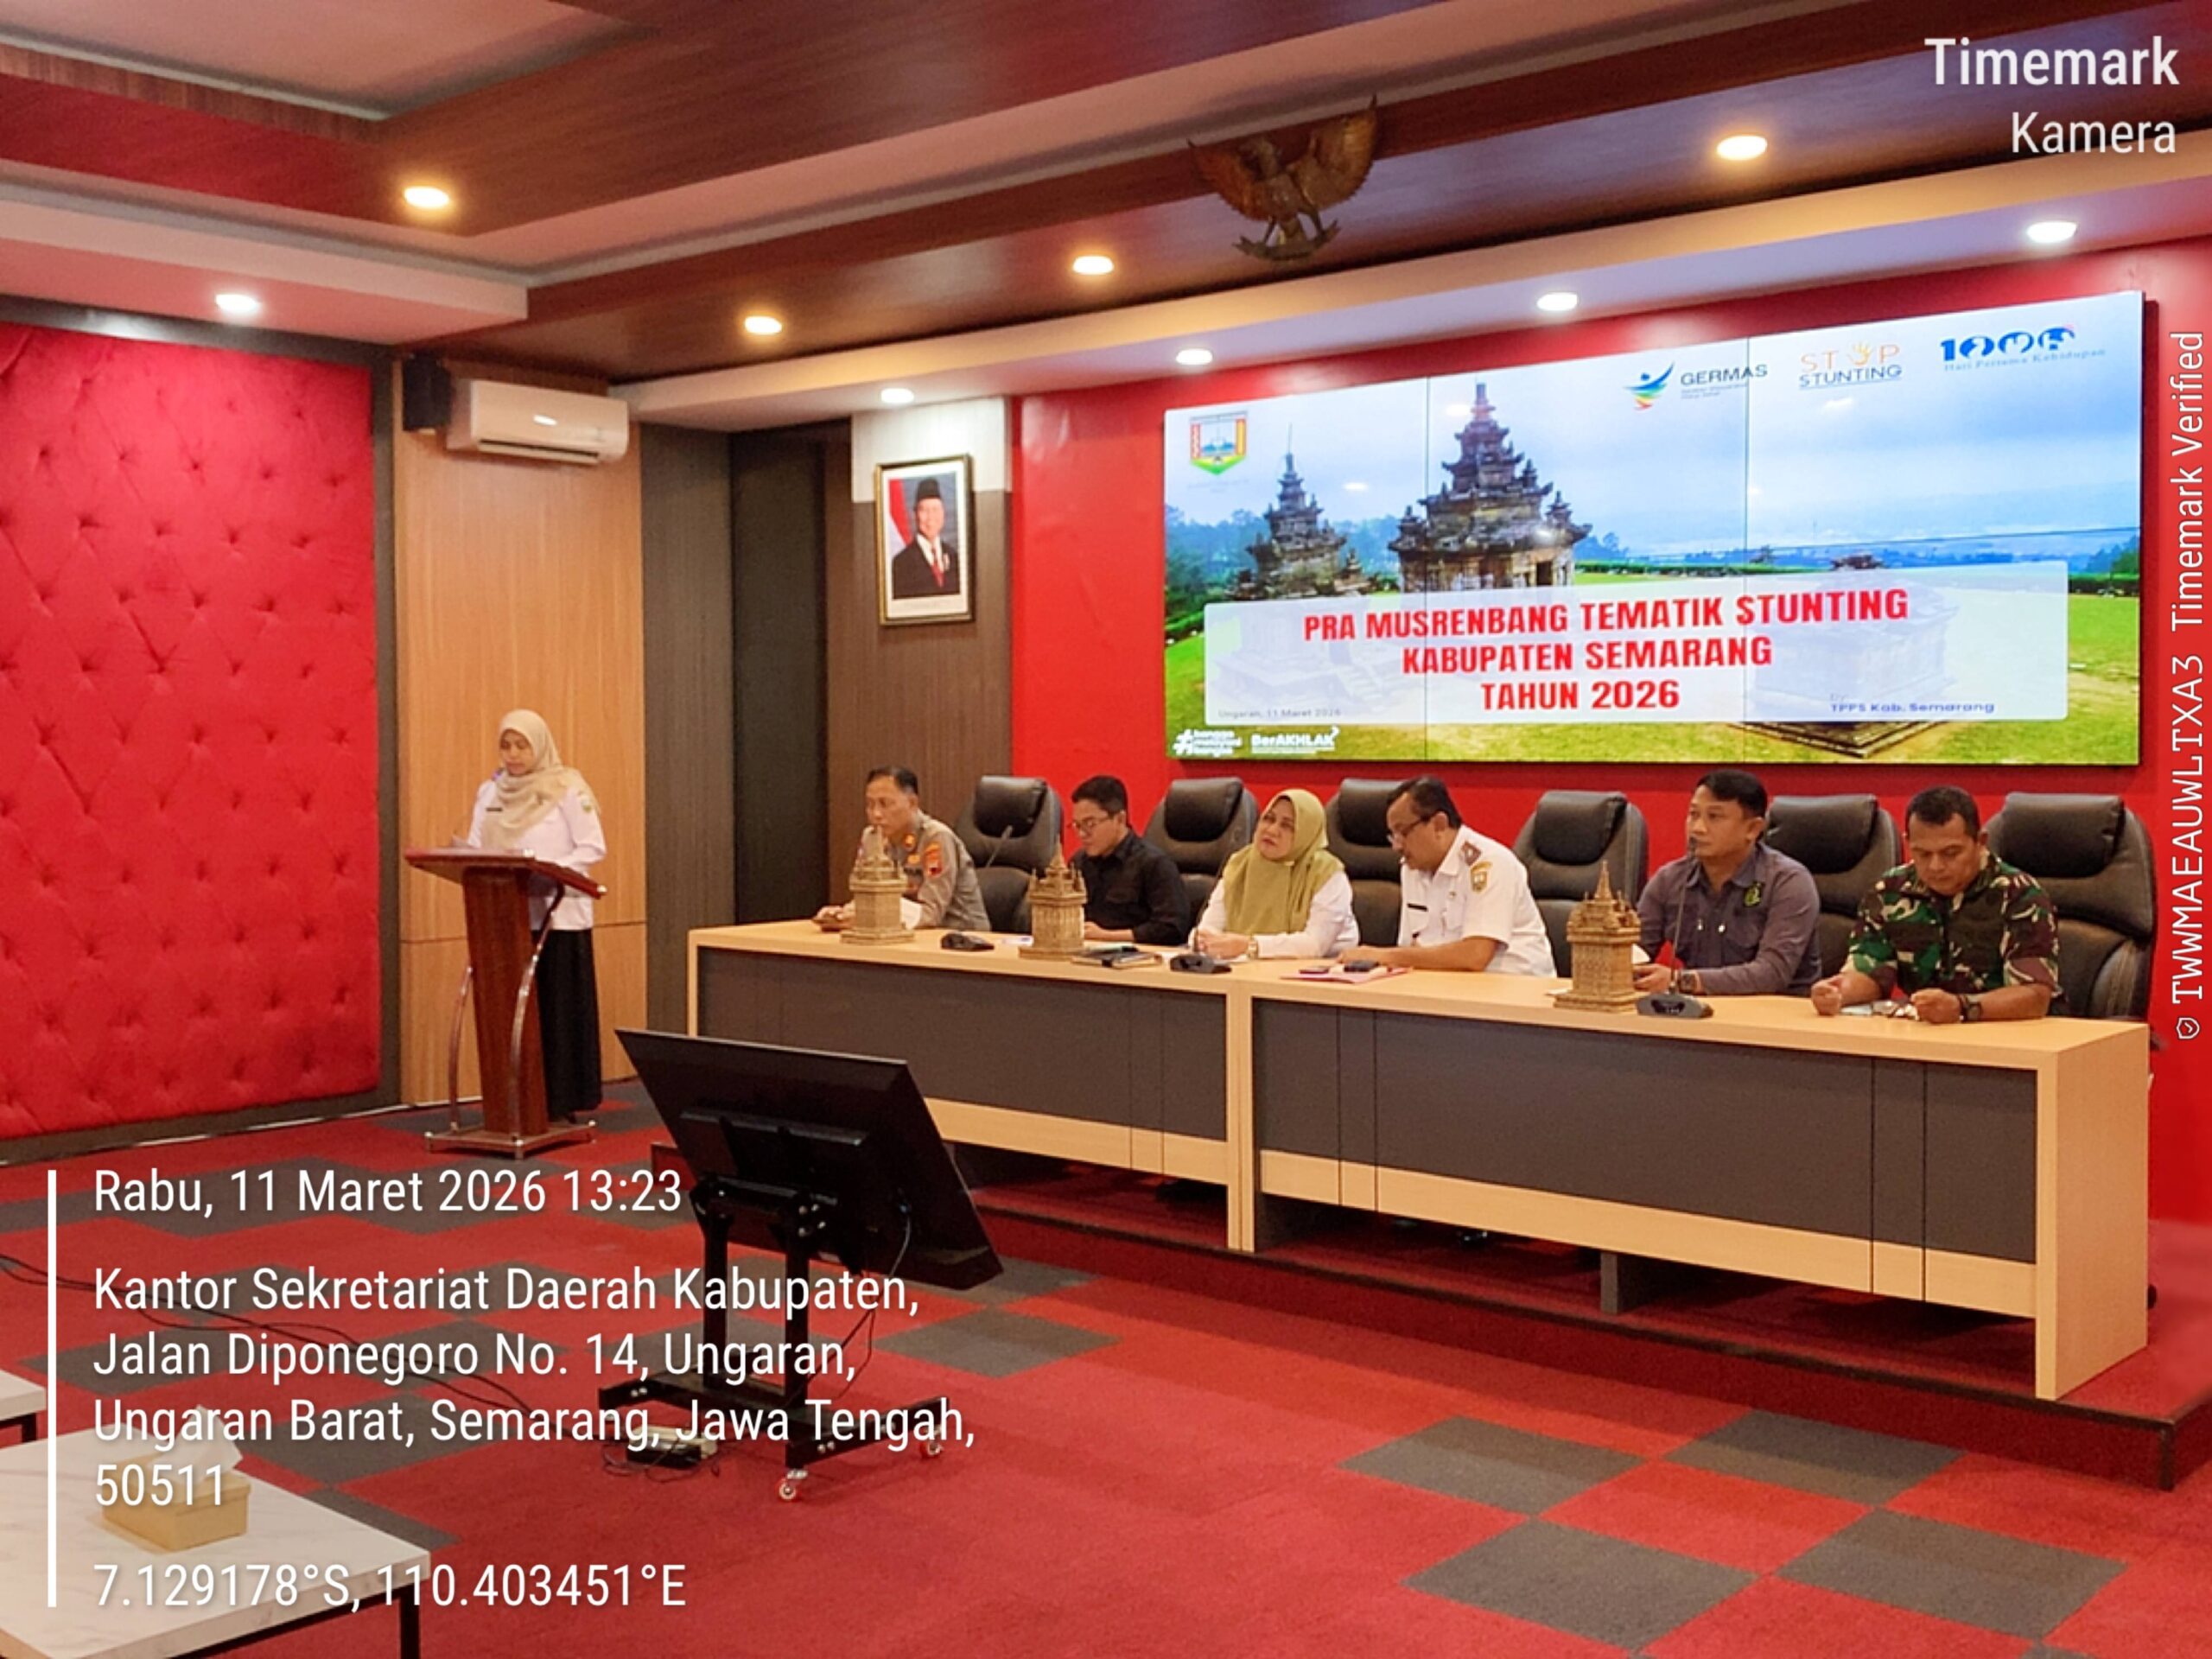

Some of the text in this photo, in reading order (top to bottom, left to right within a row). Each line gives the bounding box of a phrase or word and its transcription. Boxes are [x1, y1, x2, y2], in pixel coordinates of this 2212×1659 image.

[1681, 364, 1768, 385] GERMAS
[1799, 364, 1903, 388] STUNTING
[1304, 588, 1910, 640] PRA MUSRENBANG TEMATIK STUNTING
[1402, 636, 1772, 674] KABUPATEN SEMARANG
[1481, 680, 1681, 710] TAHUN 2026
[1830, 702, 1995, 714] TPPS Kab. Semarang
